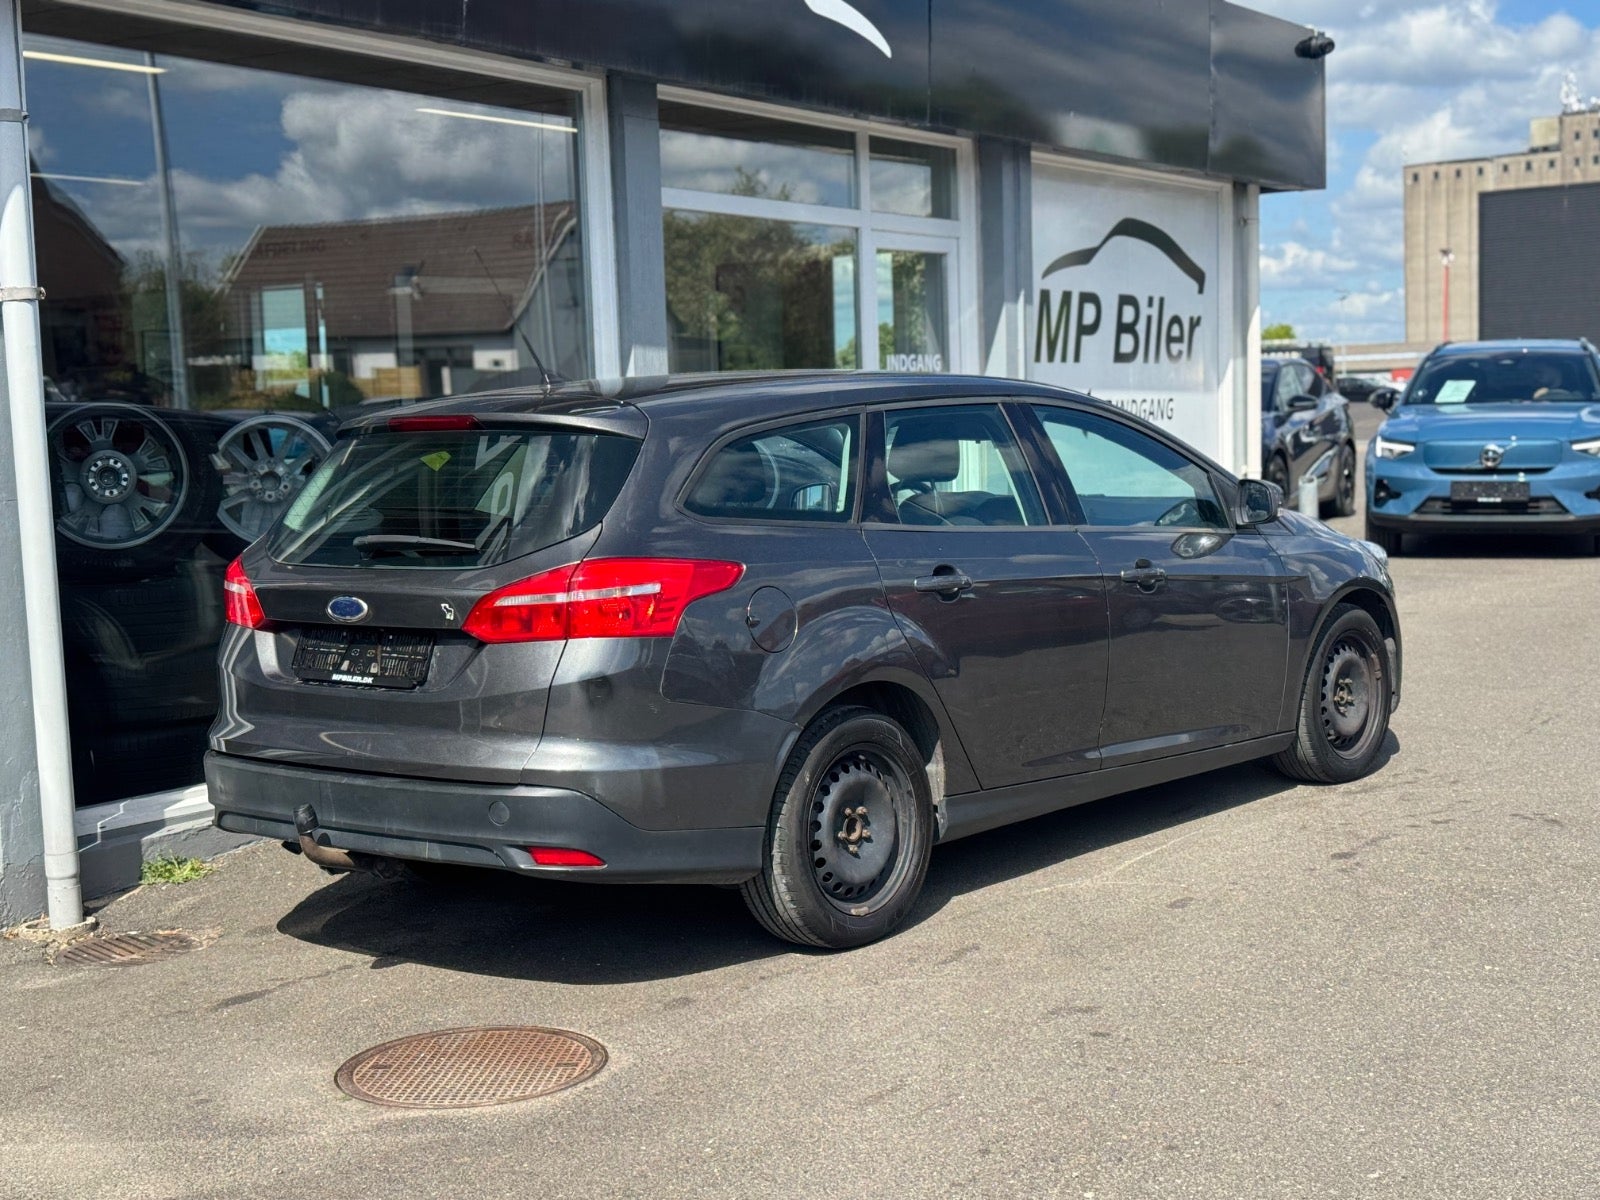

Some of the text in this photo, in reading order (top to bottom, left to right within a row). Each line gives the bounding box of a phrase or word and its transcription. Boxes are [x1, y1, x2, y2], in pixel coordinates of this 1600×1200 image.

[1034, 288, 1202, 364] MP Biler
[886, 354, 941, 371] INDGANG
